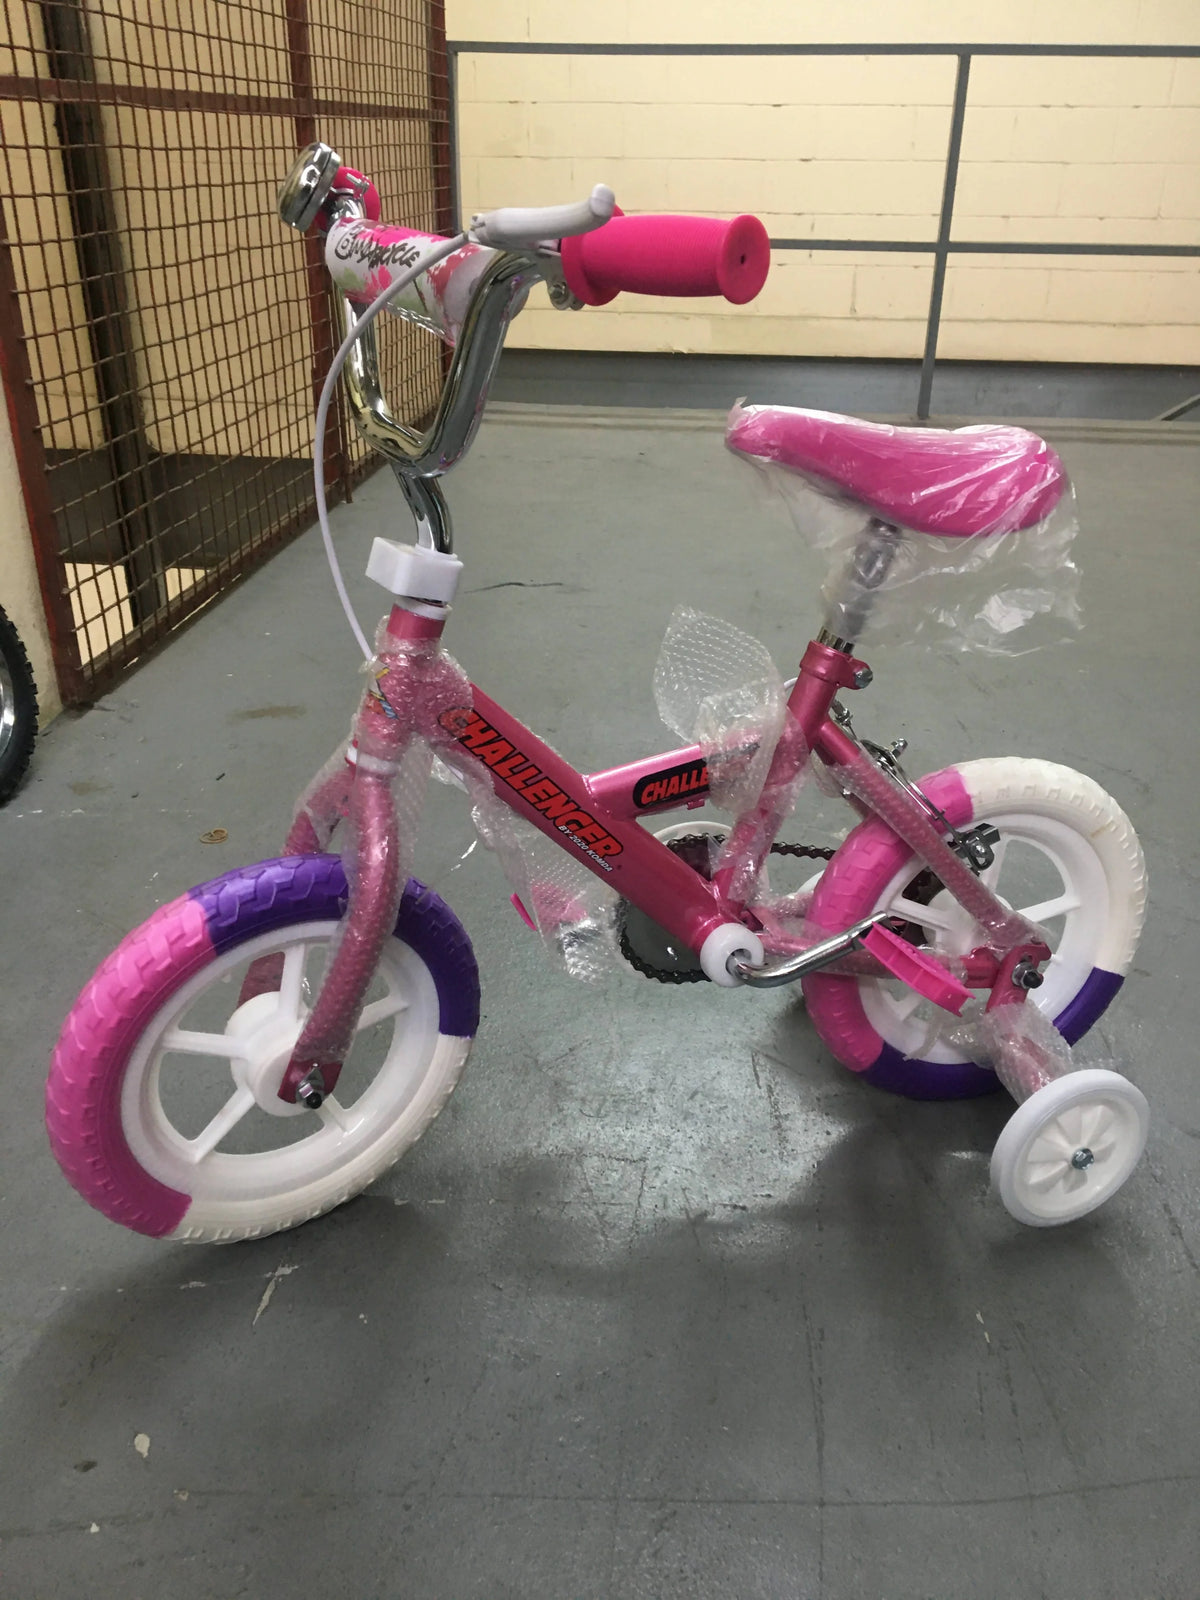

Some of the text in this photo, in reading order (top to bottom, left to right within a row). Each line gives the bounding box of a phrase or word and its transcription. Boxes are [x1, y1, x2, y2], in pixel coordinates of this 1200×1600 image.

[438, 706, 623, 858] CHALLENGER
[641, 767, 708, 803] CHALLE
[558, 825, 572, 834] BY
[570, 834, 590, 851] 2020
